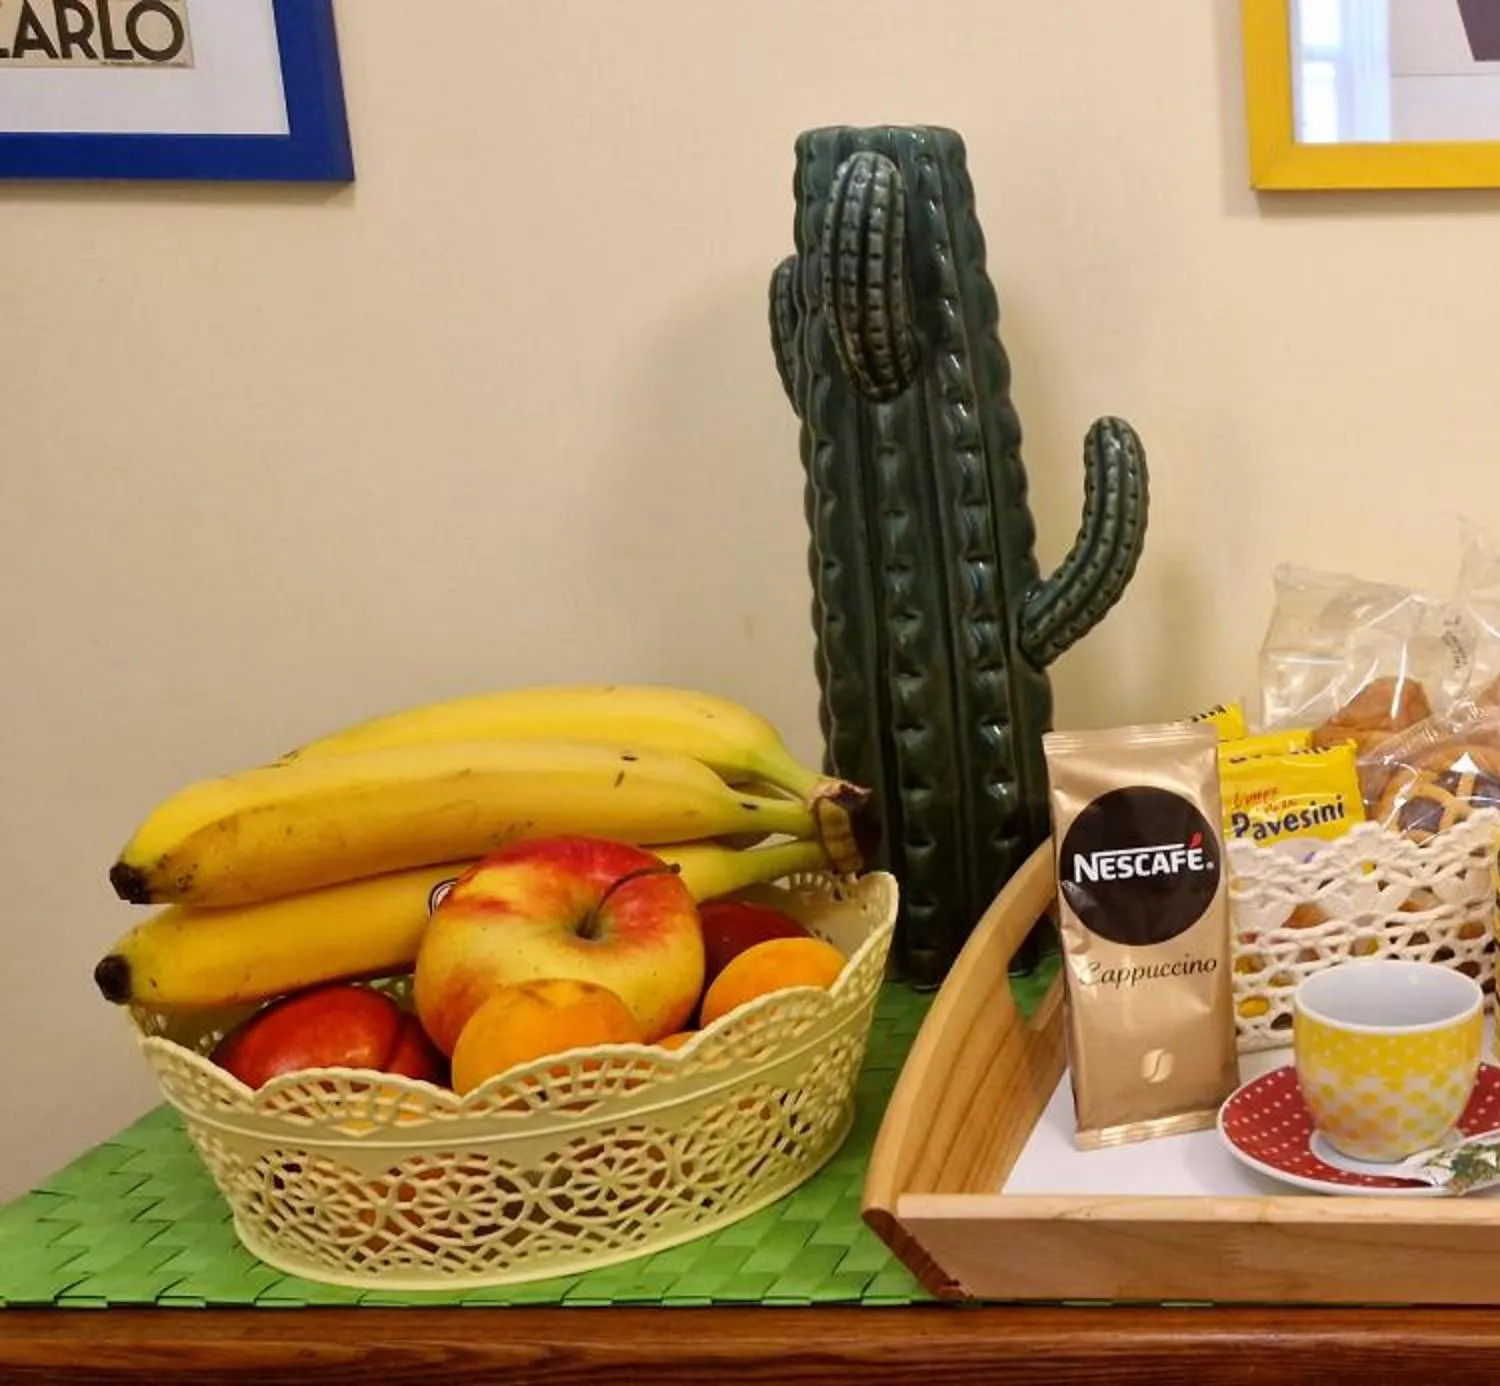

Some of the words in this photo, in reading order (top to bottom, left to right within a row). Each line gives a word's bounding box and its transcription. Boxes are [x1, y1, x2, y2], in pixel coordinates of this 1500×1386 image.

[0, 0, 184, 62] ARLO
[1231, 794, 1345, 841] Pavesini
[1079, 953, 1217, 989] Cappuccino
